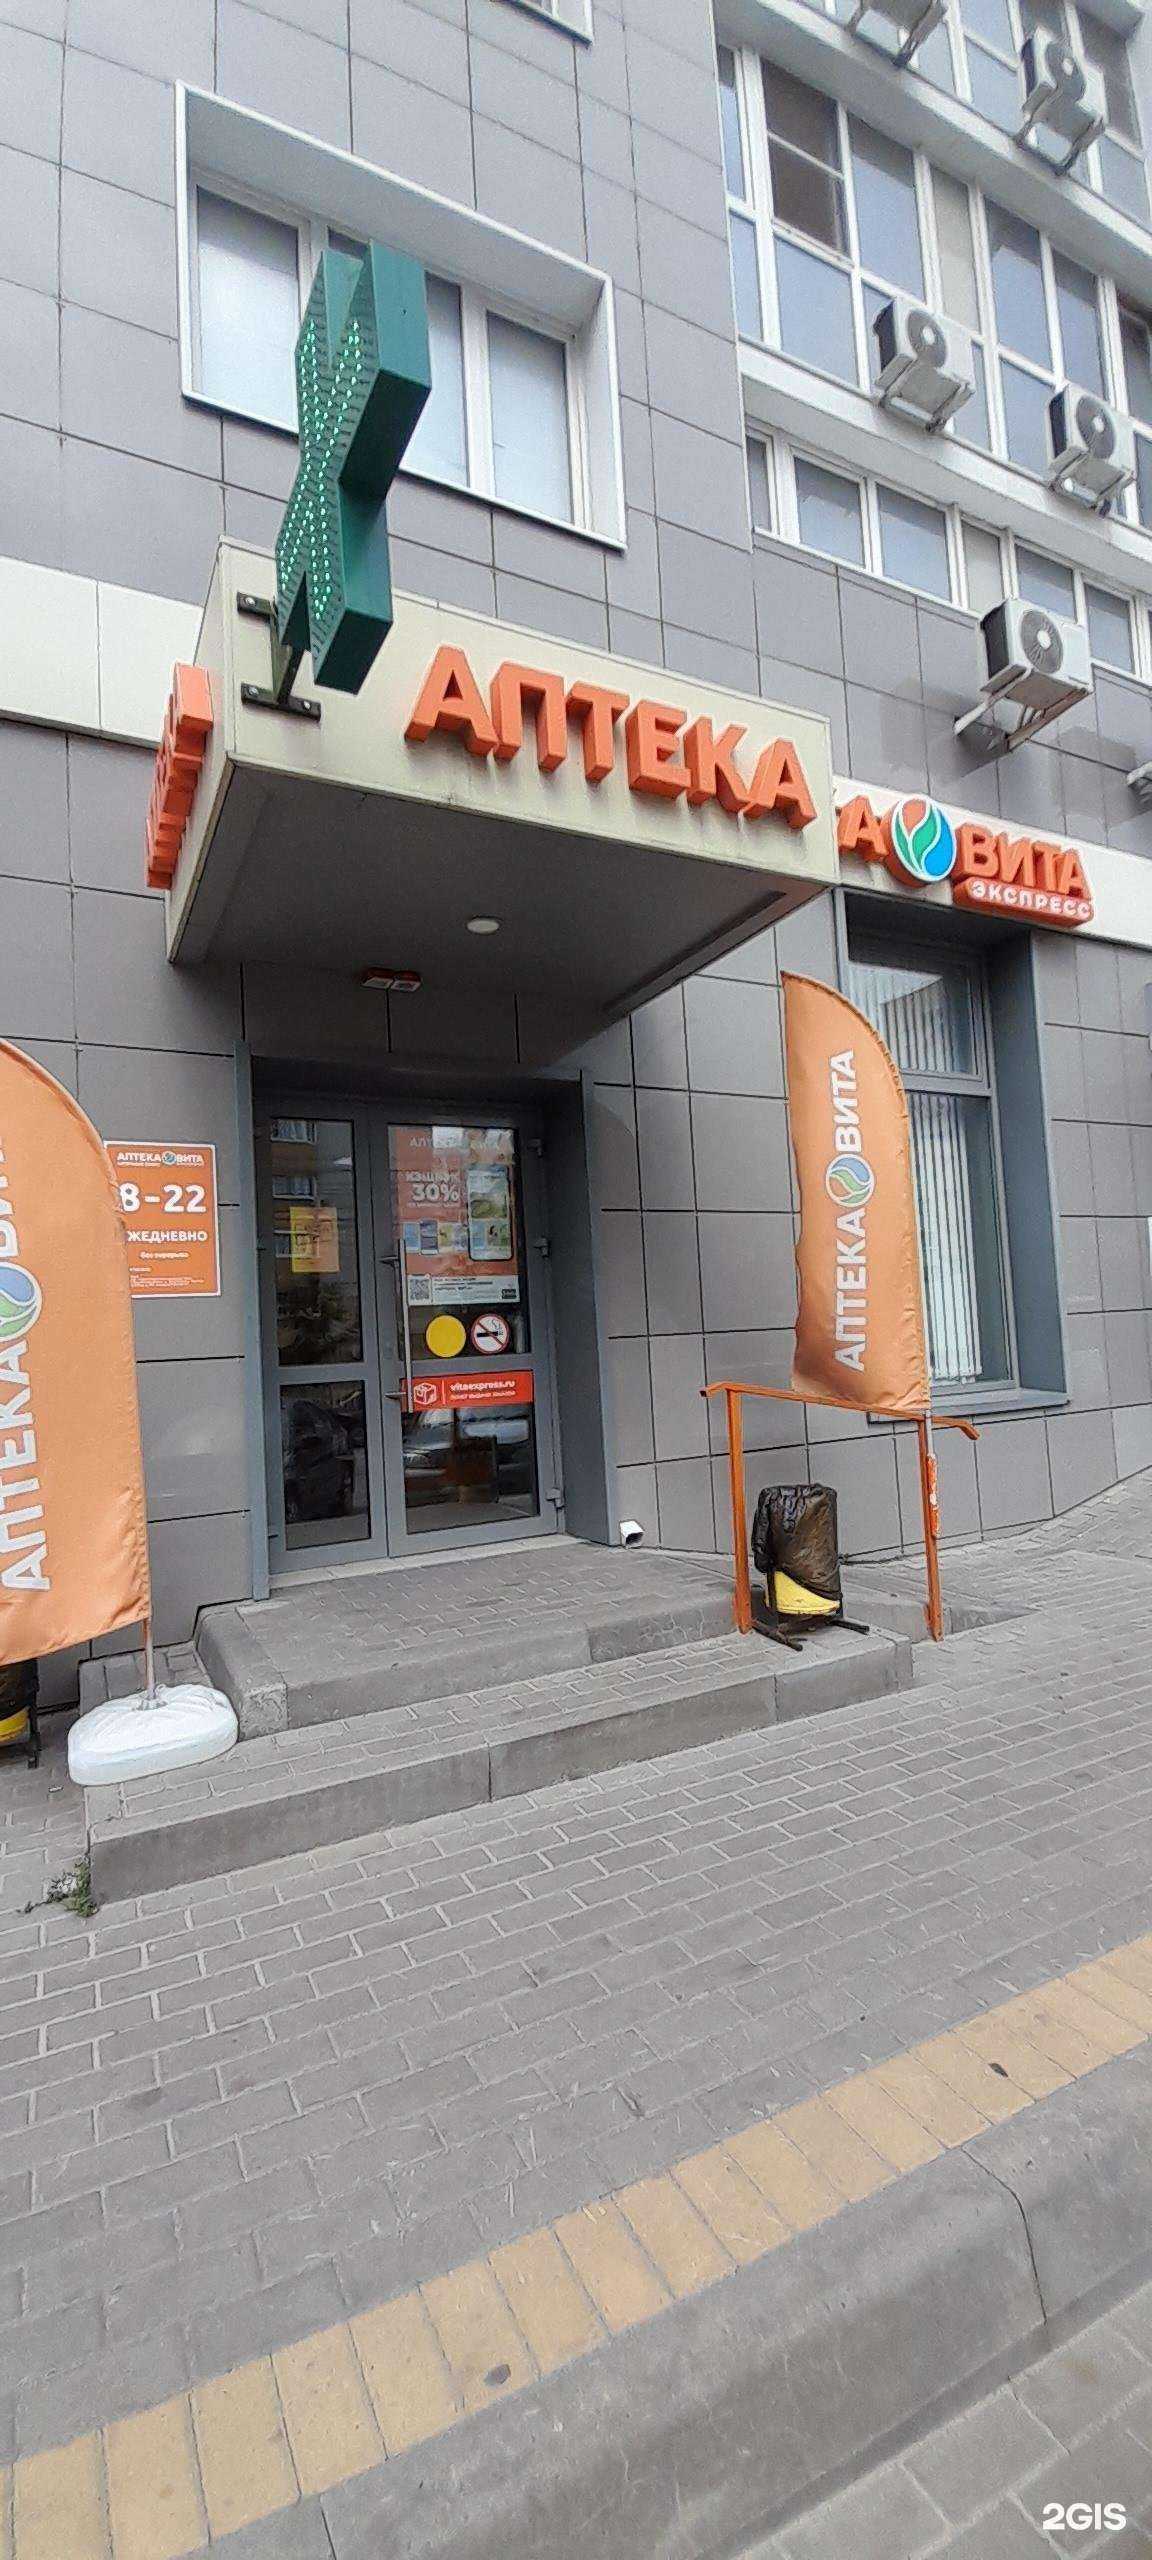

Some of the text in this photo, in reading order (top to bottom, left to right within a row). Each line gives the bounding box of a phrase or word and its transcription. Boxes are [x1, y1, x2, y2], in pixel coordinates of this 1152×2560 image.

[404, 645, 817, 830] АПТЕКА
[954, 822, 1091, 897] ВИТА
[971, 880, 1093, 918] ЭКСПРЕСС
[117, 1152, 204, 1165] АПТЕКА ВИТА
[412, 1183, 460, 1203] 30%
[828, 1049, 868, 1372] АПТЕКА ВИТА
[127, 1230, 208, 1243] ЖЕДНЕВНО
[0, 1339, 51, 1590] АПТЕКА
